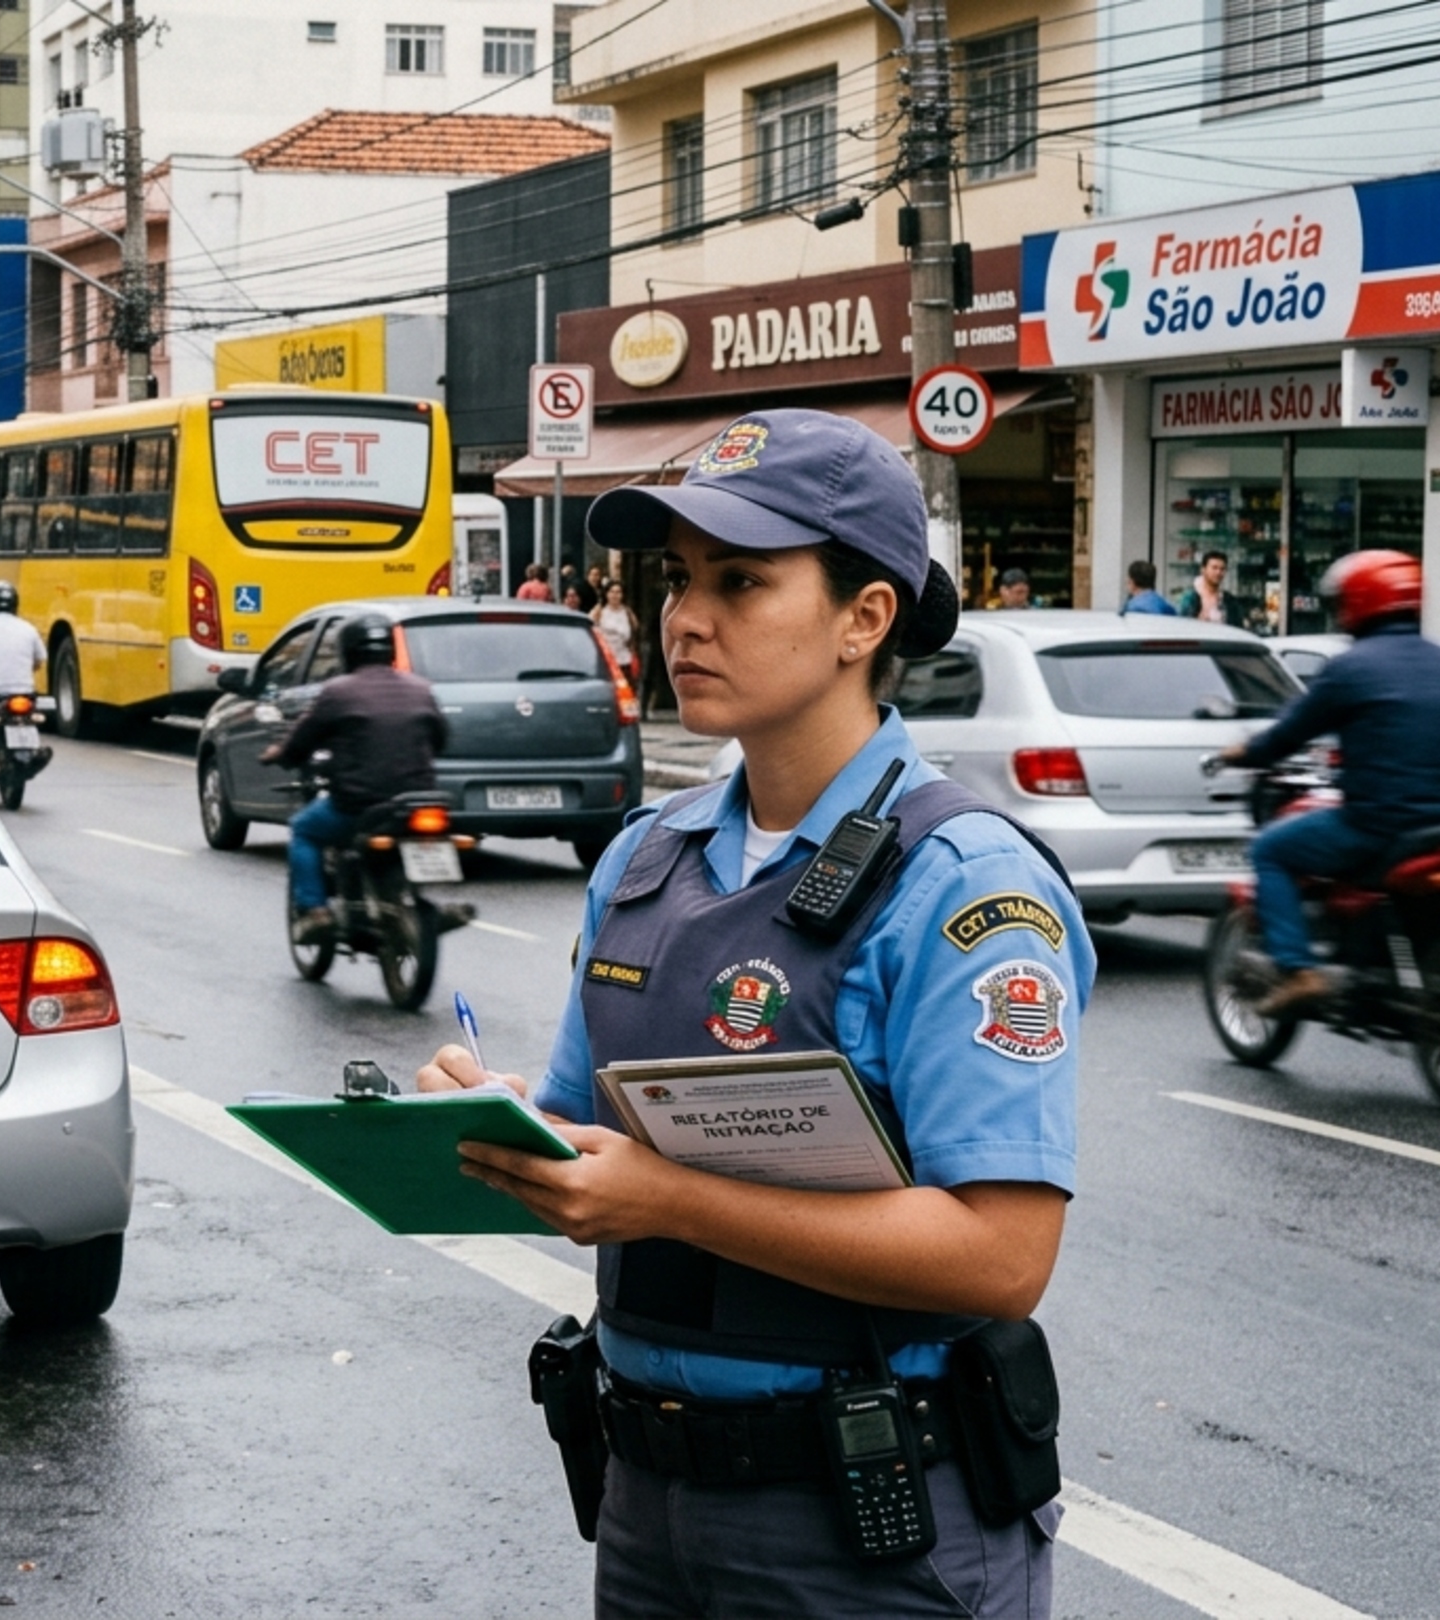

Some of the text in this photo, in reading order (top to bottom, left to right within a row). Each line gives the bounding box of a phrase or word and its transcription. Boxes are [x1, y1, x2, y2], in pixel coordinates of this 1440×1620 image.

[1152, 215, 1322, 277] Farmácia
[1144, 271, 1326, 336] São João
[712, 296, 881, 370] PADARIA
[924, 385, 978, 418] 40
[1163, 382, 1263, 427] FARMÁCIA
[265, 431, 380, 474] CET
